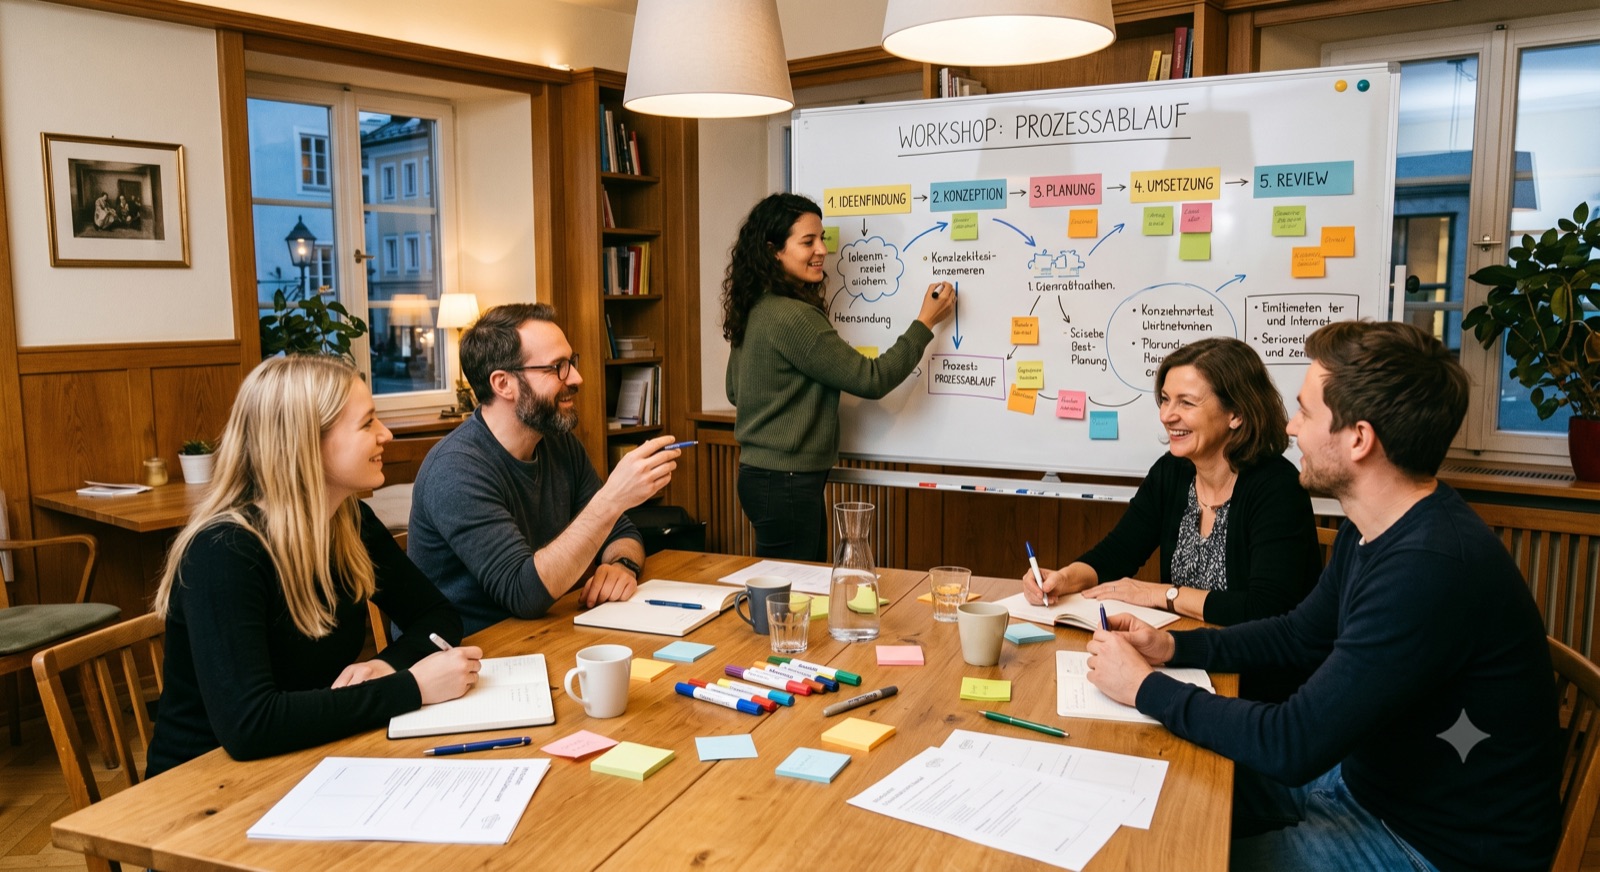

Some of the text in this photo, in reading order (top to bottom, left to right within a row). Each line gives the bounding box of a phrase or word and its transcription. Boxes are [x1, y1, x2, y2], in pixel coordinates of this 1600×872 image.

[899, 103, 1190, 149] WORKSHOP: PROZESSABLAUF
[1135, 177, 1213, 193] 4. UMSETZUNG
[1260, 171, 1328, 188] 5. REVIEW
[933, 188, 1002, 203] 2. KONZEPTION
[1034, 183, 1095, 198] 3. PLANUNG
[828, 193, 906, 208] 1. IDEENFINDUNG
[1267, 315, 1282, 327] und
[1266, 347, 1283, 357] und
[1072, 354, 1109, 371] Planung
[934, 373, 997, 388] PROZESSABLAUF
